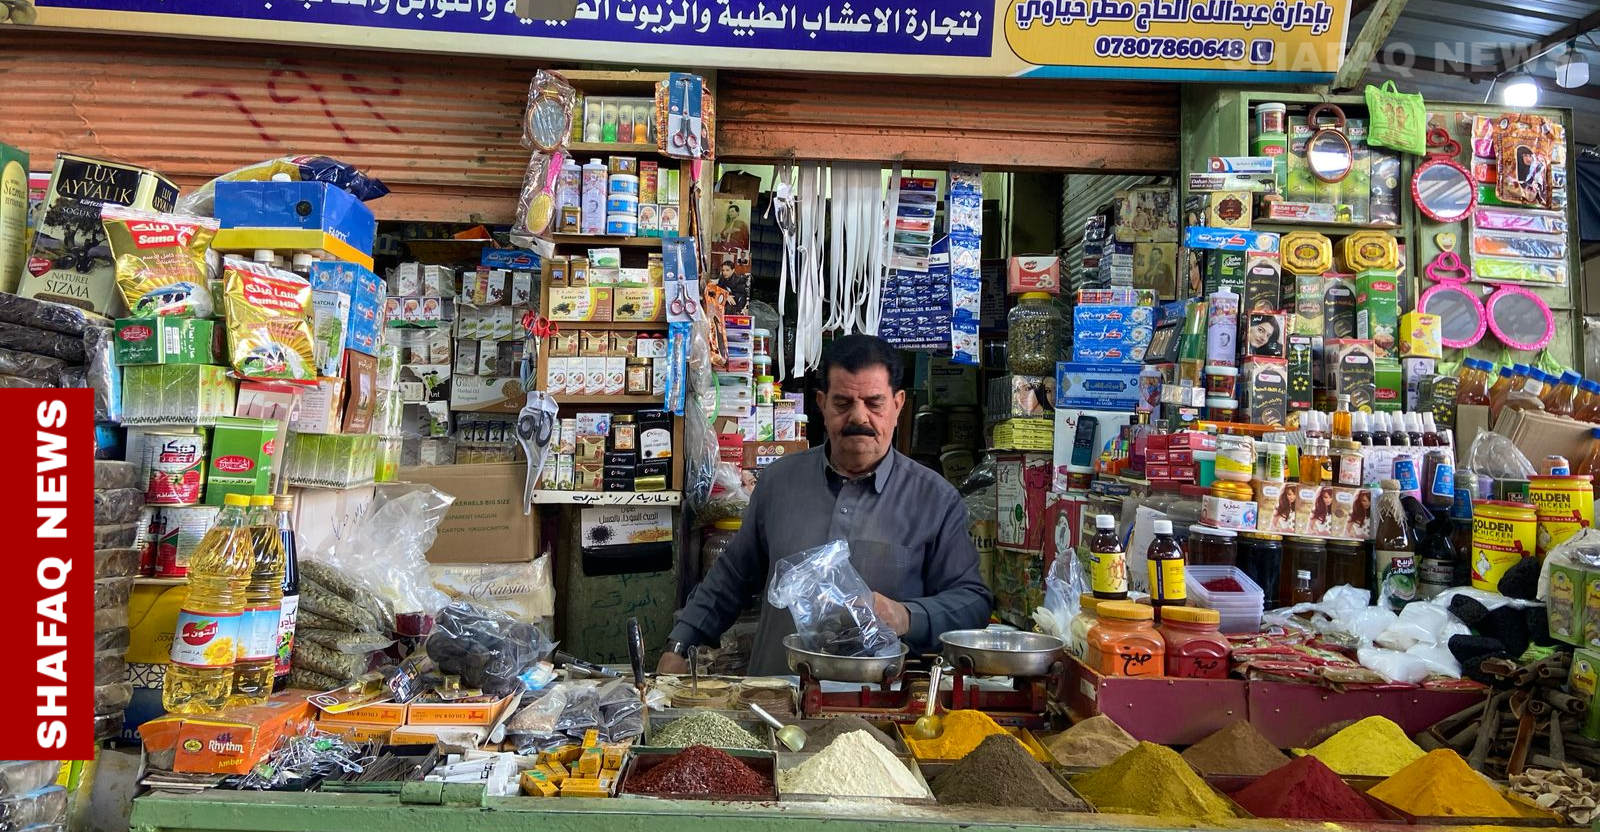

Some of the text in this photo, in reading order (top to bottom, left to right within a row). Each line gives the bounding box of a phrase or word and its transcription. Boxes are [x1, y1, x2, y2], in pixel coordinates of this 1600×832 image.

[616, 0, 711, 33] والزيوت
[718, 0, 796, 36] الطبية
[802, 2, 899, 39] الاعشاب
[1136, 0, 1189, 30] الحاج
[1191, 0, 1268, 28] عبدالله
[1271, 0, 1332, 33] بإدارة
[905, 8, 982, 43] لتجارة
[1096, 37, 1244, 58] 07807860648
[85, 164, 118, 185] LUX
[59, 179, 133, 204] AYVALIK
[138, 235, 175, 245] Sama
[51, 271, 90, 285] NATUREL
[44, 280, 90, 299] SIZMA
[1530, 492, 1571, 504] GOLDEN
[1473, 518, 1514, 533] GOLDEN
[1477, 529, 1513, 539] CHICKEN
[469, 581, 533, 600] Raisins
[208, 739, 245, 753] Rhythm
[218, 758, 245, 768] Amber
